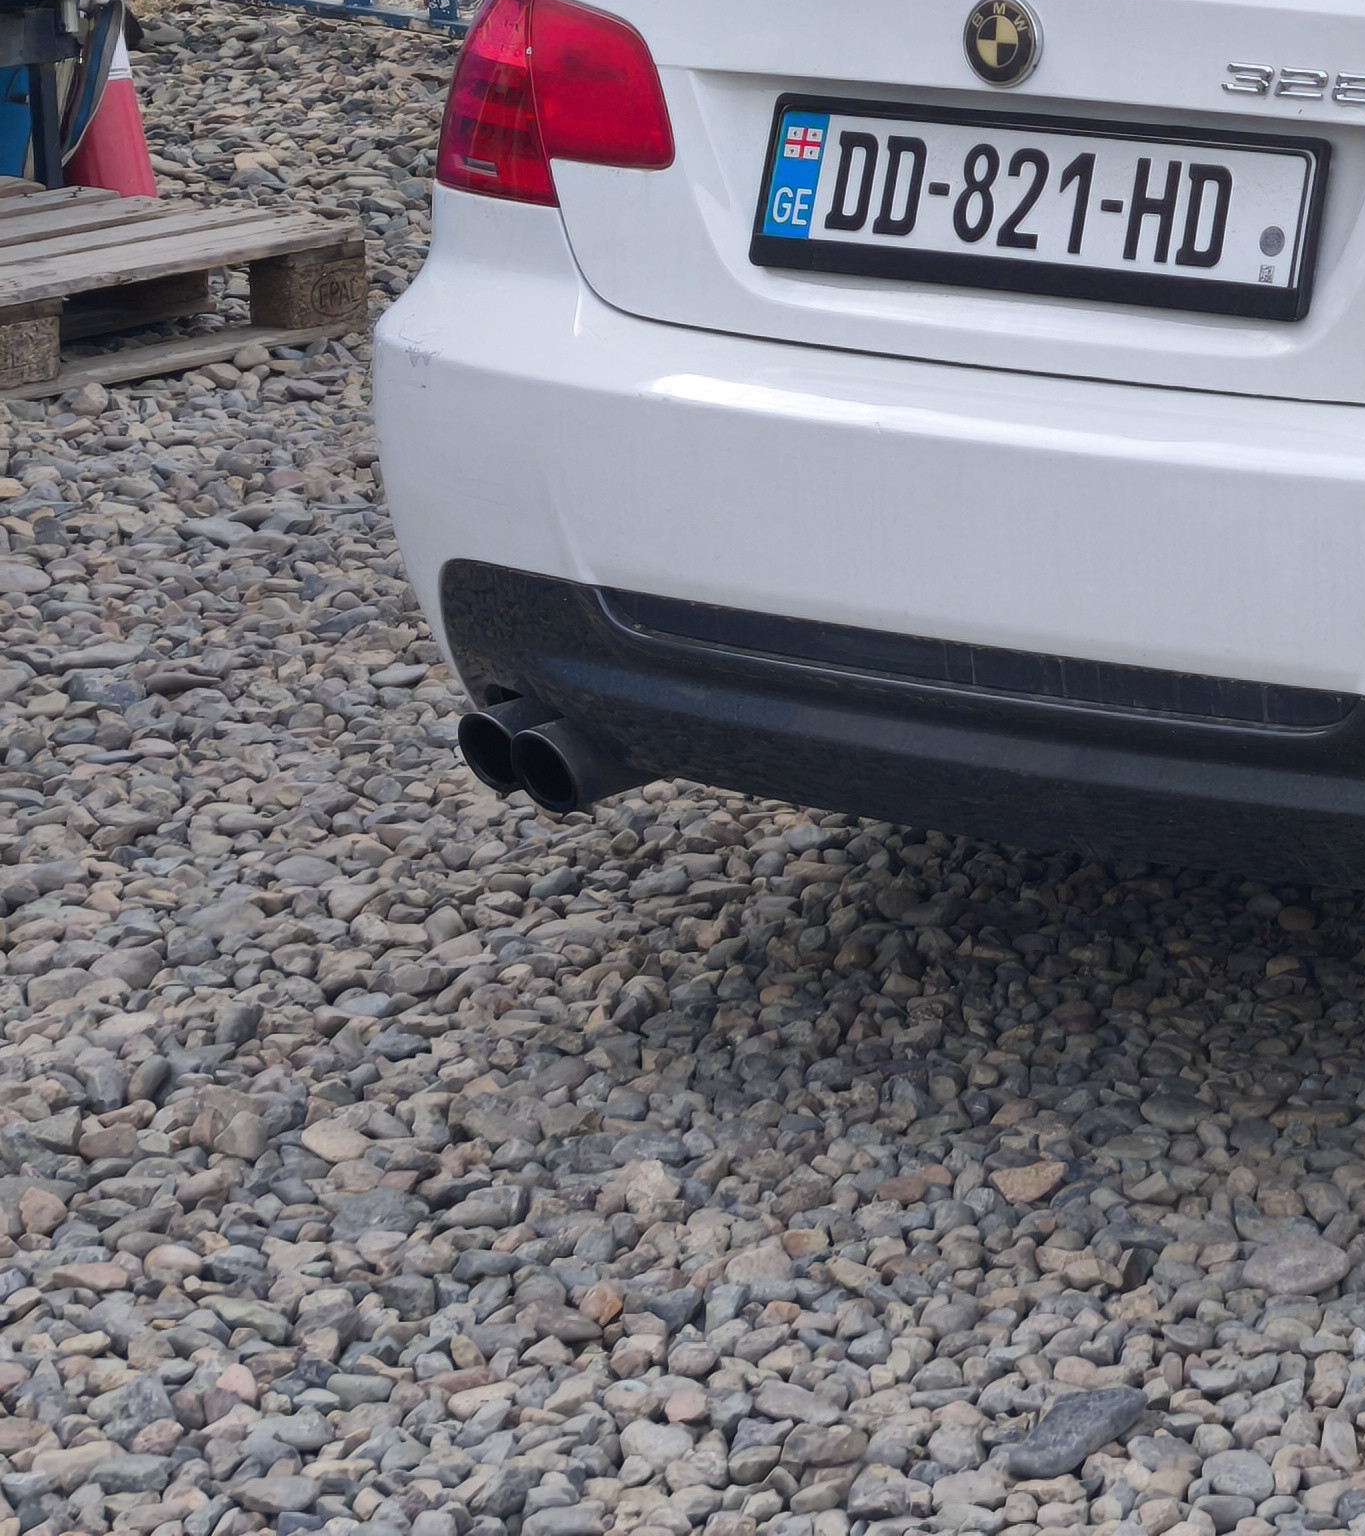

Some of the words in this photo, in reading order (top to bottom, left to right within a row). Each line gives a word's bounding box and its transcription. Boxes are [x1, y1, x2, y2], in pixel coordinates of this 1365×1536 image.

[972, 1, 1028, 33] BMW
[772, 186, 813, 227] GE
[824, 130, 1232, 268] DD-821-HD
